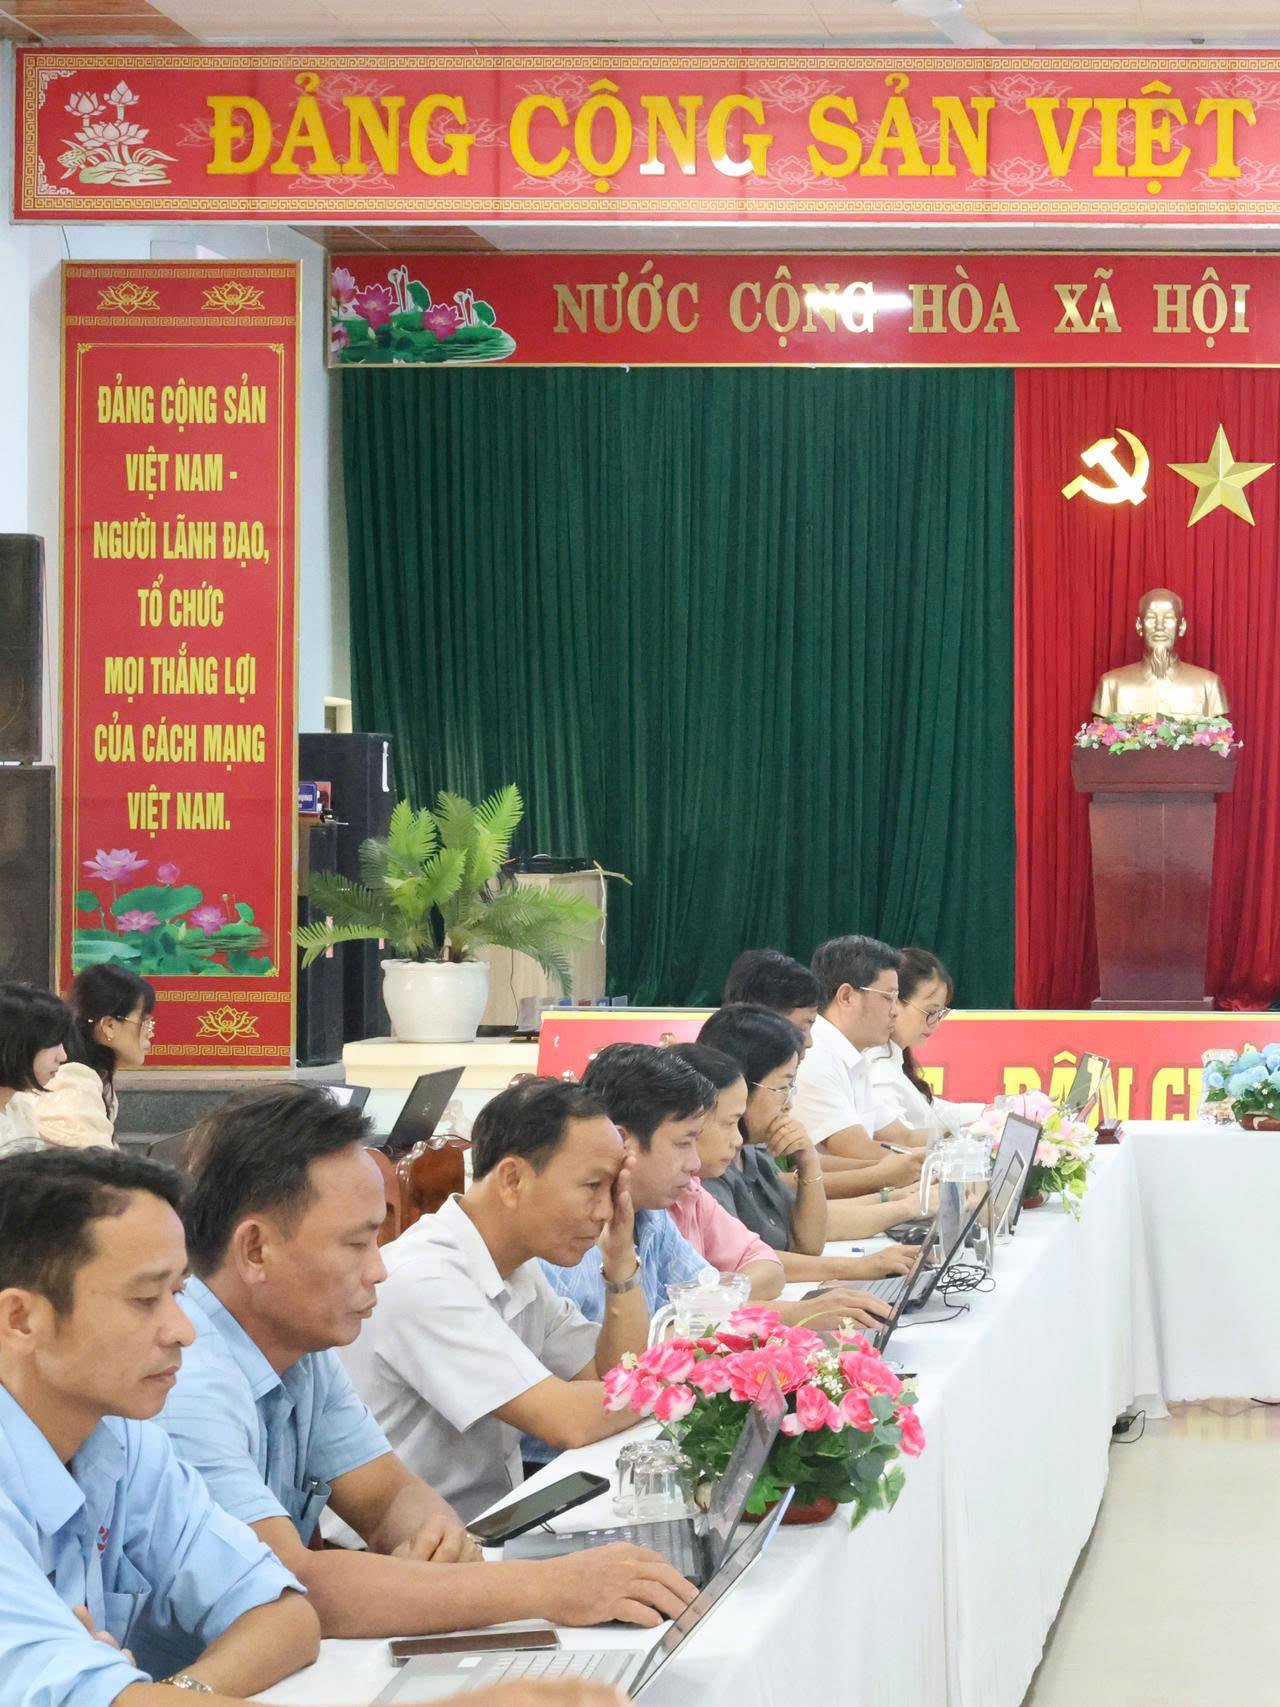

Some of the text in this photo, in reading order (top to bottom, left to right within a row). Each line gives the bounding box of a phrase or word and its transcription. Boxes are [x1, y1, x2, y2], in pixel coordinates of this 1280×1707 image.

[207, 73, 470, 177] ĐẢNG
[509, 79, 772, 193] CỘNG
[807, 73, 993, 178] SẢN
[1025, 80, 1256, 195] VIỆT
[554, 261, 699, 333] NƯỚC
[730, 266, 878, 347] CỘNG
[908, 266, 1019, 333] HÒA
[1054, 268, 1122, 333] XÃ
[1153, 267, 1250, 348] HỘI
[97, 373, 266, 432] ĐẢNG CỘNG SẢN
[125, 446, 170, 499] VIỆT
[175, 454, 223, 491] NAM
[93, 512, 270, 567] NGƯỜI LÃNH ĐẠO,
[137, 574, 224, 628] TỔ CHỨC
[104, 641, 256, 704] MỌI THẮNG LỢI
[94, 711, 265, 771] CỦA CÁCH MẠNG
[127, 784, 231, 838] VIỆT NAM.
